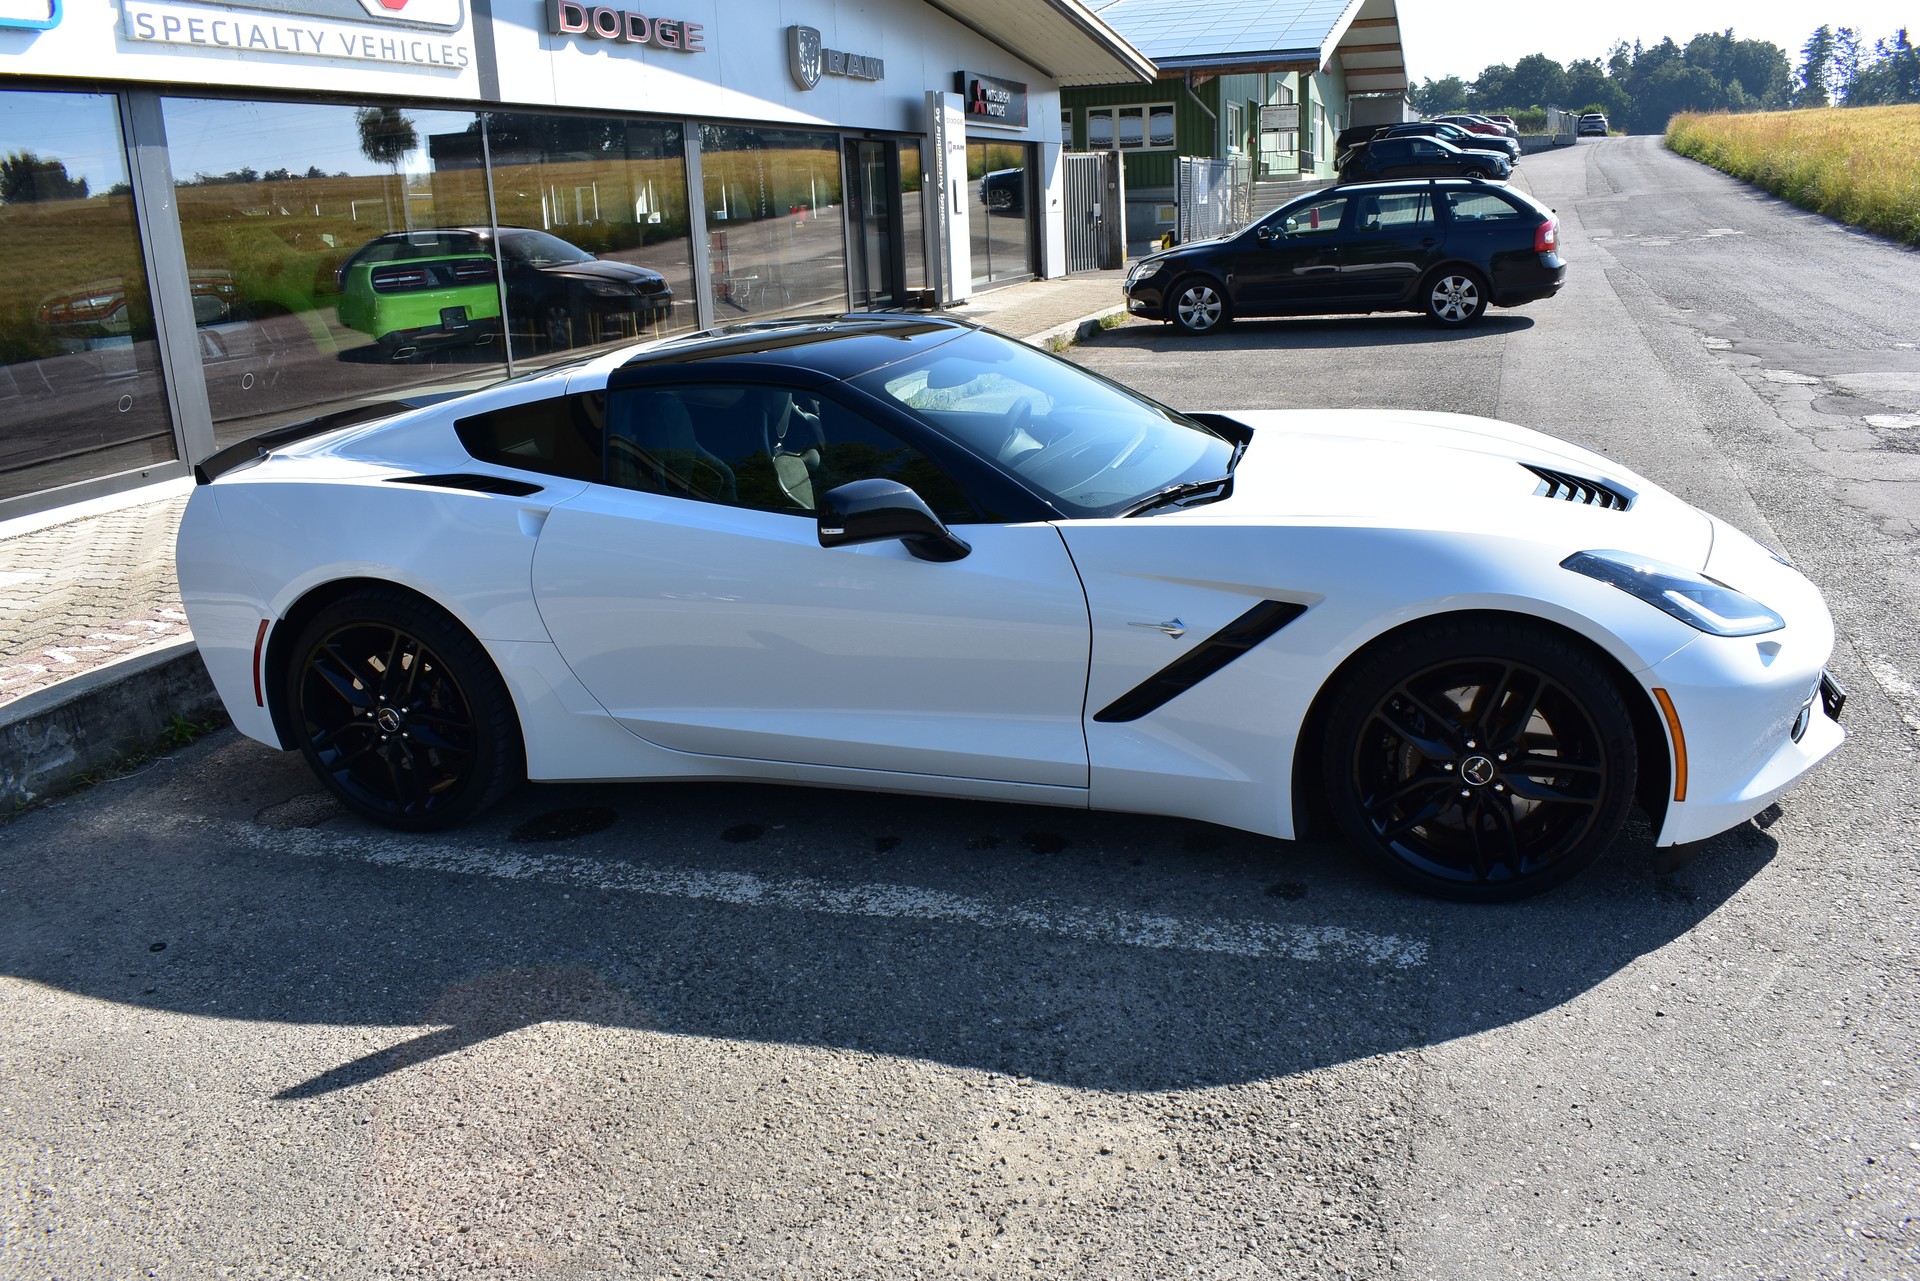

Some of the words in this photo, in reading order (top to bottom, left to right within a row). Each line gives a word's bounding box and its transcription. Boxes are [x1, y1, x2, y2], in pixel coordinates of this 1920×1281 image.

[136, 12, 325, 54] SPECIALTY
[339, 32, 470, 67] VEHICLES
[554, 0, 706, 52] DODGE
[826, 48, 885, 80] RAM
[935, 107, 941, 123] AG
[986, 103, 1006, 117] MOTORS
[935, 126, 944, 190] Automobile
[952, 143, 965, 152] RAM
